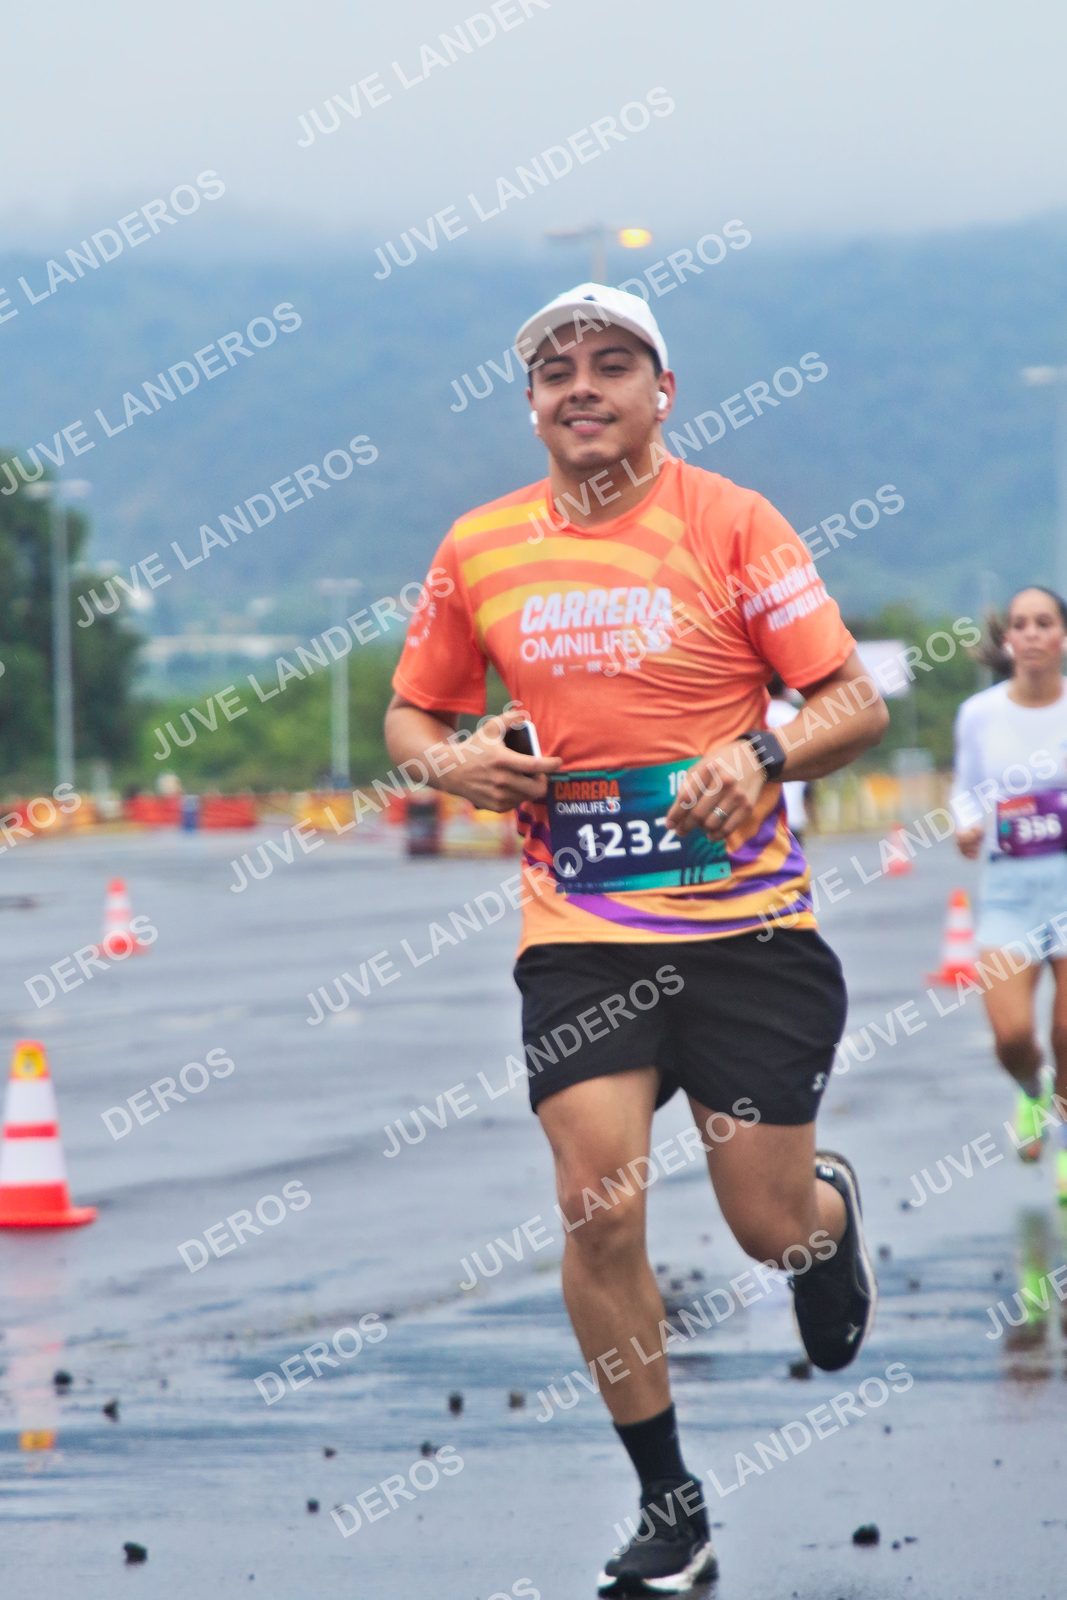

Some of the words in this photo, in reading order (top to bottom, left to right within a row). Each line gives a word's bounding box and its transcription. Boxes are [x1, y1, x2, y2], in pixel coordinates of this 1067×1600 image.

[520, 586, 673, 634] CARRERA
[520, 629, 639, 663] OMNILIFE
[554, 779, 620, 800] CARRERA
[555, 800, 605, 815] OMNILIFE
[576, 817, 683, 859] 1232
